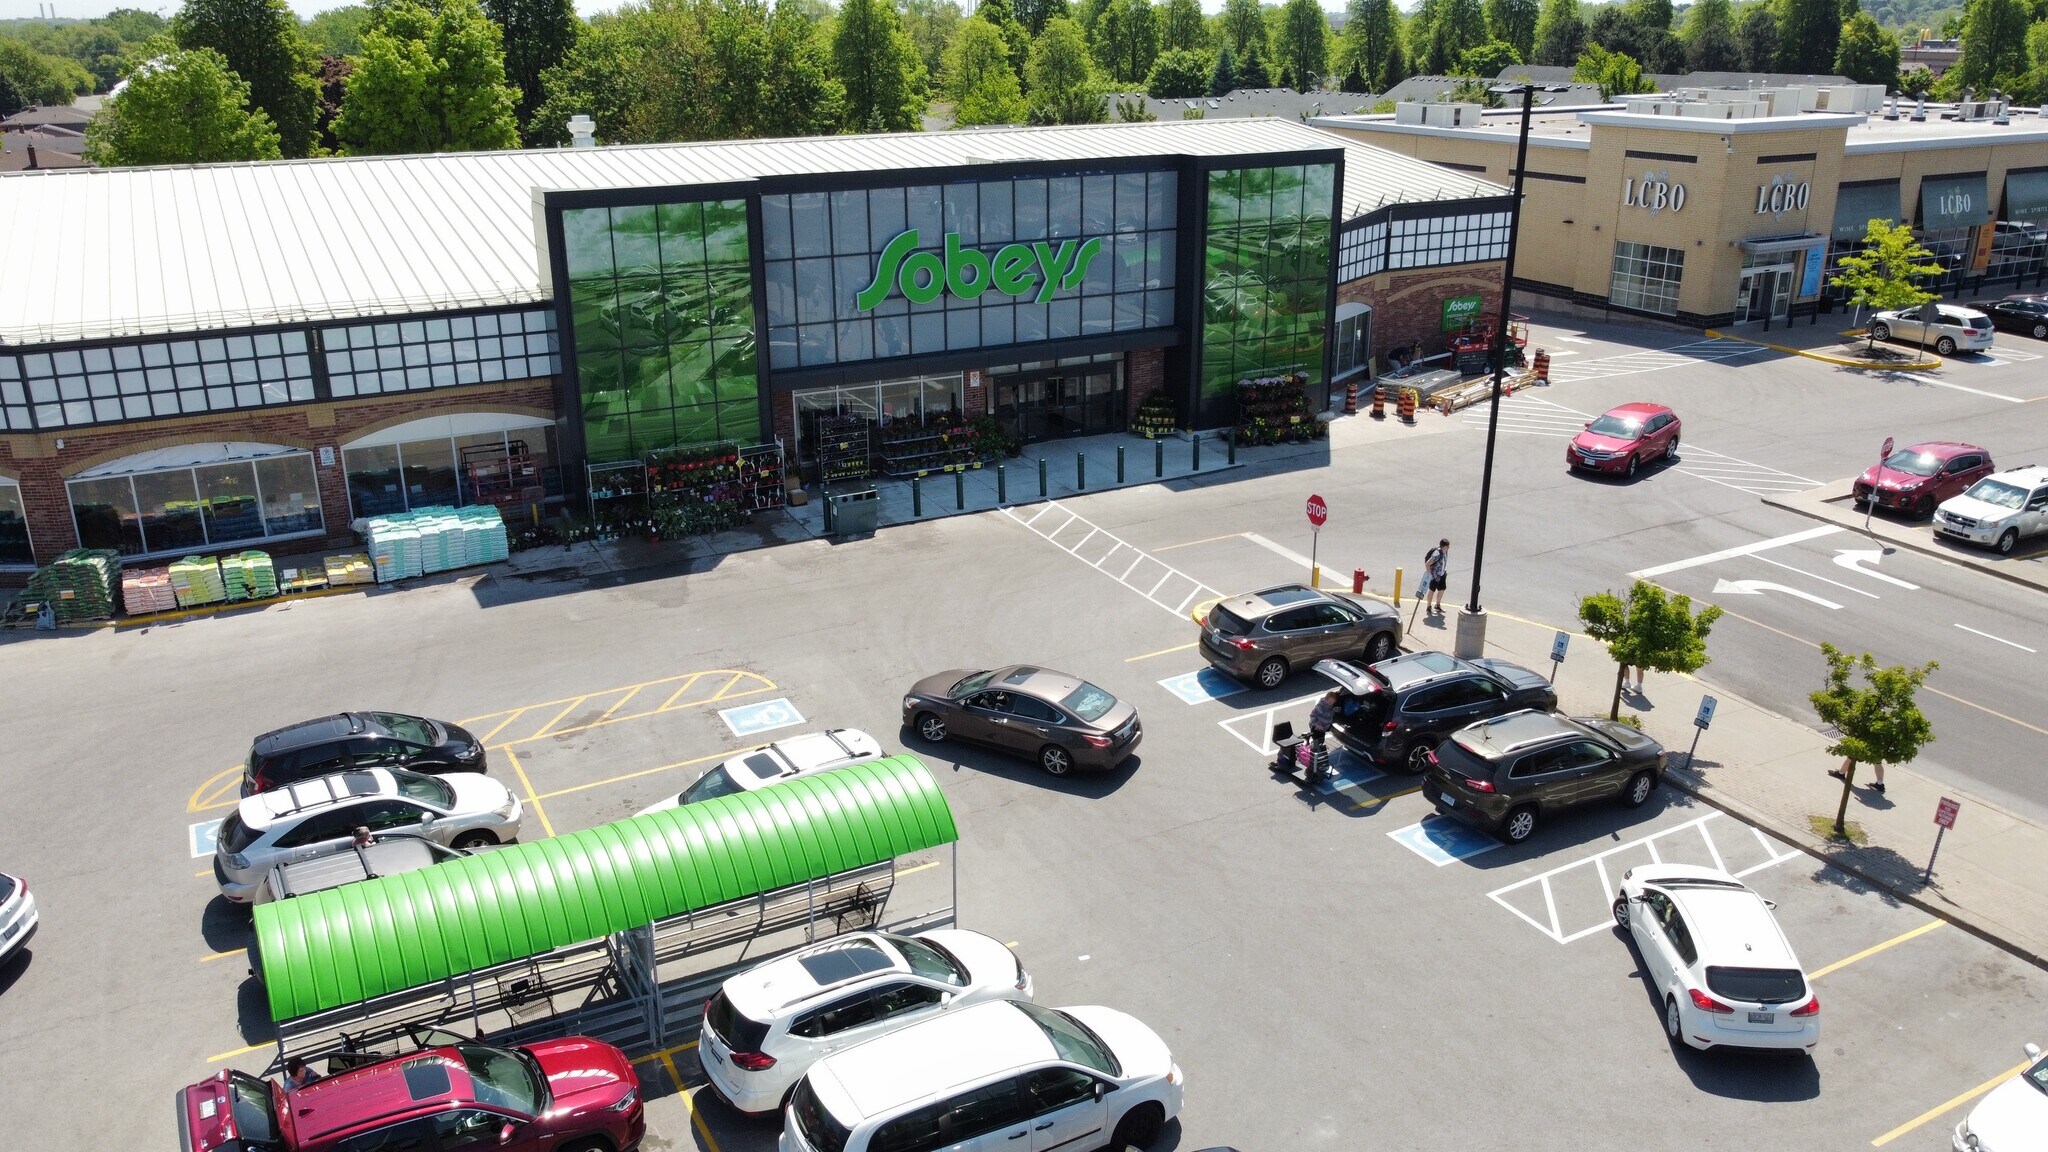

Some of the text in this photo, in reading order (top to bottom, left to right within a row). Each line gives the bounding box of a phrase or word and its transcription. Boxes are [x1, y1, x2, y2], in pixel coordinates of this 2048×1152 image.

[1623, 178, 1686, 213] LCBO
[1756, 182, 1811, 215] LCBO
[1940, 193, 1972, 216] LCBO
[857, 228, 1102, 312] Sobeys
[1447, 300, 1477, 312] Sobeys
[1307, 501, 1327, 519] STOP
